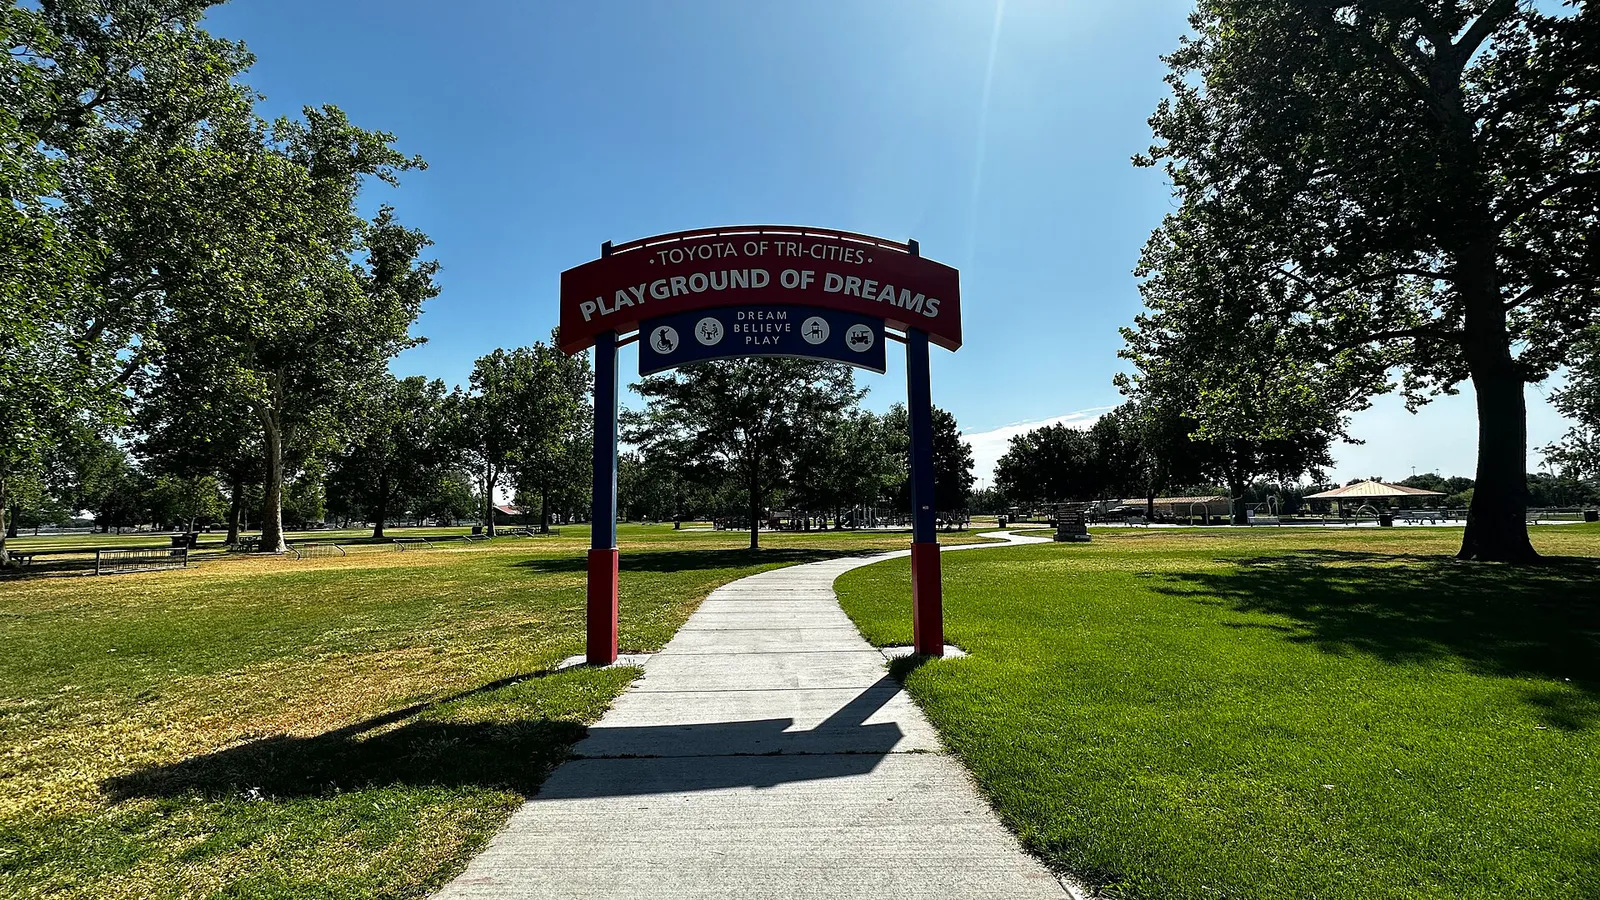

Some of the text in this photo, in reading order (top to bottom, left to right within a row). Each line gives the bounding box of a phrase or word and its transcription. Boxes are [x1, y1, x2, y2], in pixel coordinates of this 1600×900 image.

[656, 241, 865, 265] TOYOTA OF TRI-CITIES
[579, 268, 941, 322] PLAYGROUND OF DREAMS
[736, 310, 788, 321] DREAM
[733, 323, 792, 333] BELIEVE
[744, 336, 780, 346] PLAY
